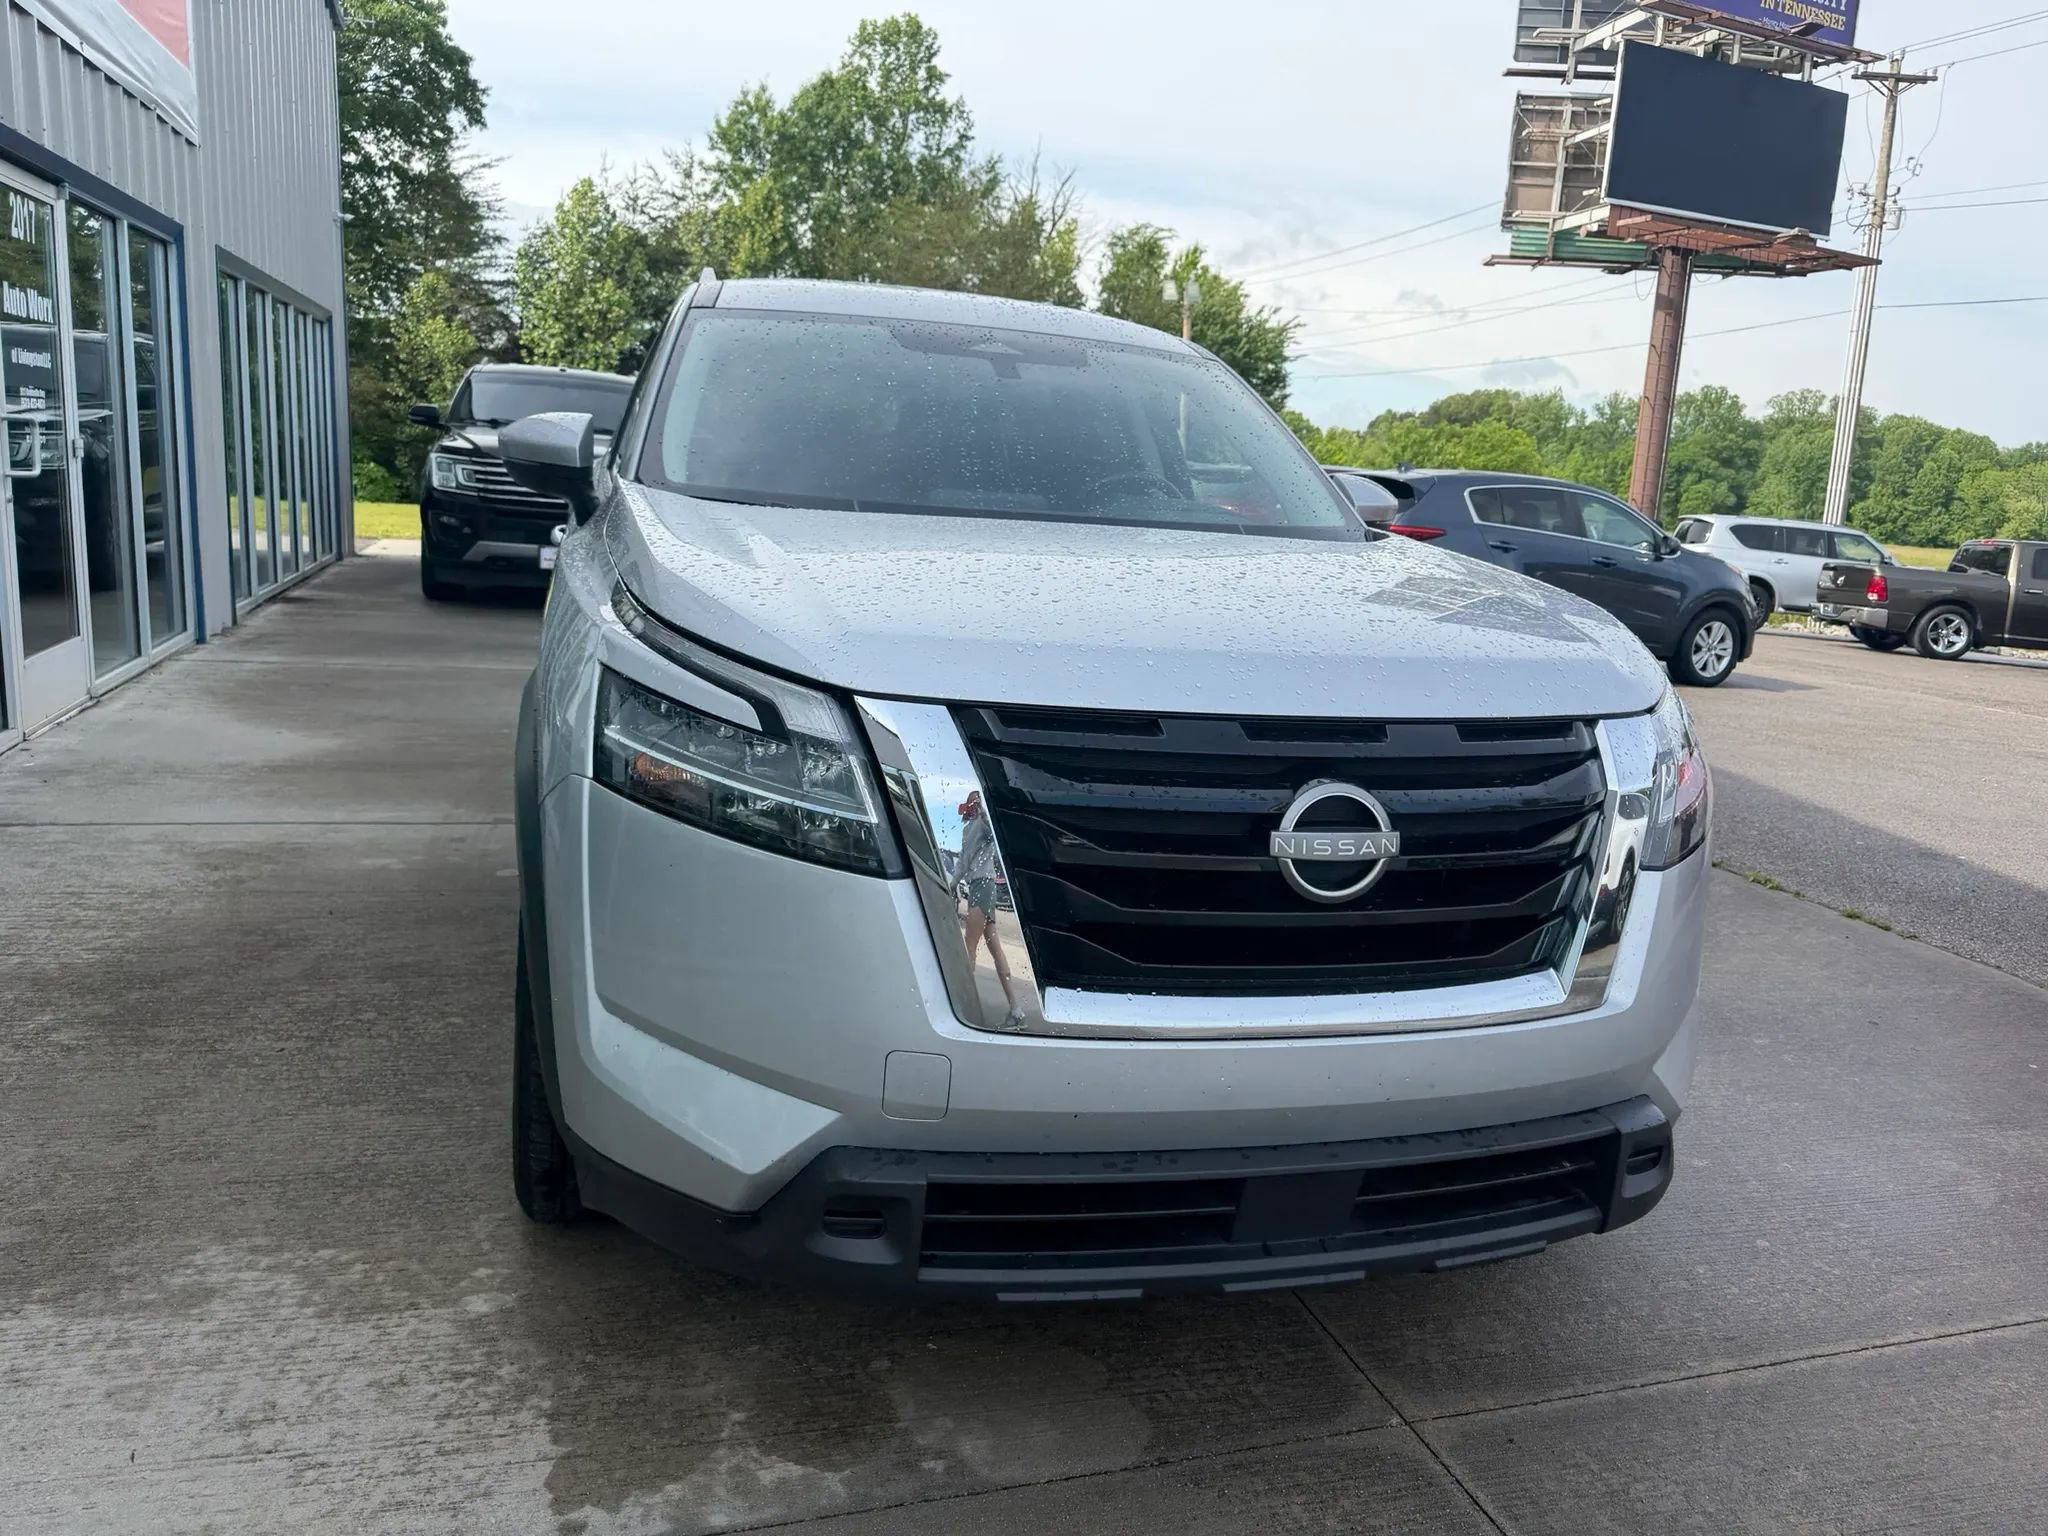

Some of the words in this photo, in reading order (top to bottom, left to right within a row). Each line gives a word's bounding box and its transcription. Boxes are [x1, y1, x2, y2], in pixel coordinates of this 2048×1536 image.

[9, 191, 36, 244] 2017
[2, 280, 28, 318] Auto
[1274, 837, 1397, 855] NISSAN
